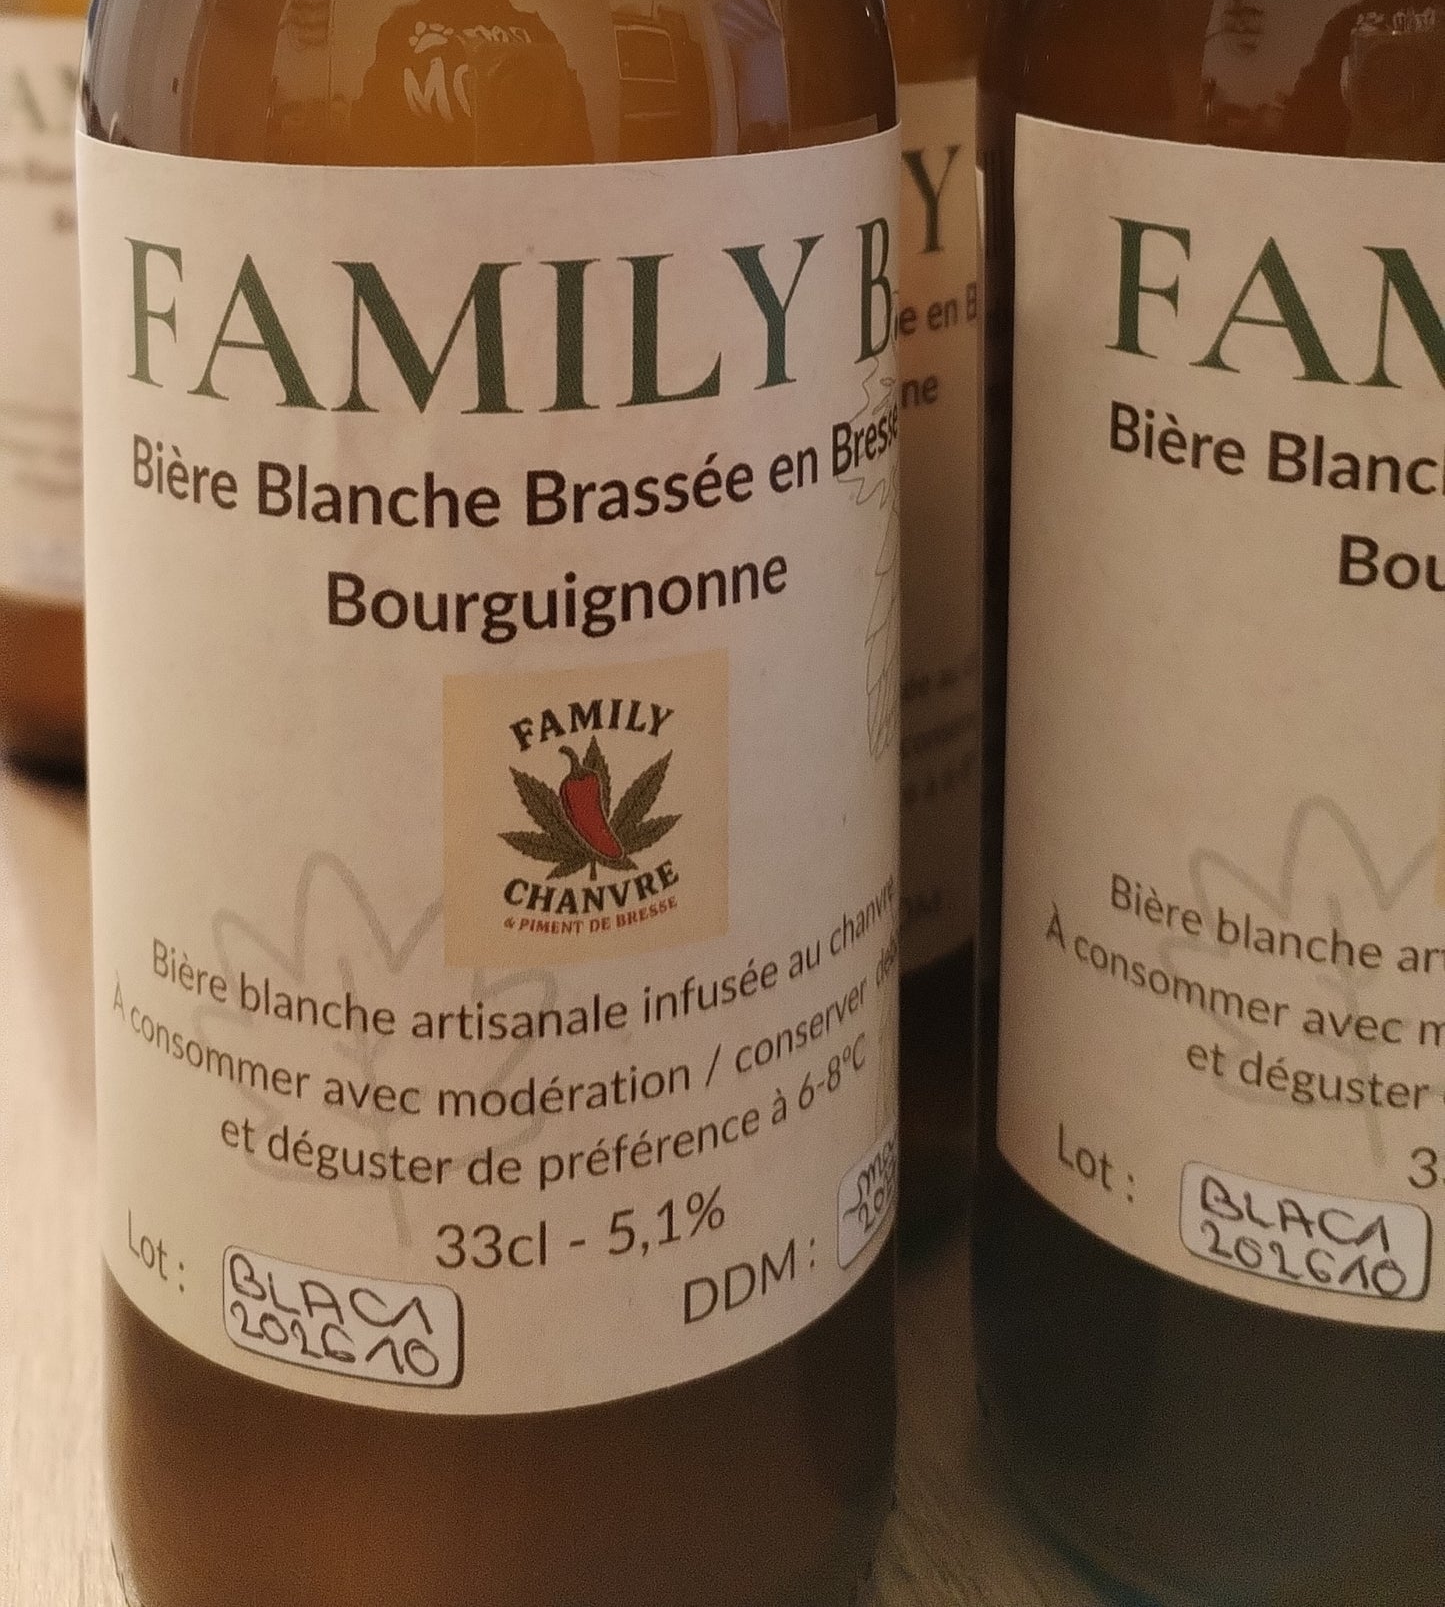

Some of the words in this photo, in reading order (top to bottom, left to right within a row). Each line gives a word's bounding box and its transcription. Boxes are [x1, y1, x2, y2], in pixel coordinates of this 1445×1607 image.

[901, 143, 961, 254] Y
[124, 234, 825, 414] FAMILY
[132, 434, 238, 512] Bière
[257, 460, 501, 529] Blanche
[526, 451, 754, 527] Brassée
[769, 446, 819, 493] en
[1109, 400, 1245, 476] Bière
[1267, 431, 1445, 497] Blanc
[327, 553, 788, 643] Bourguignonne
[509, 698, 674, 752] FAMILY
[503, 859, 679, 914] CHANVRE
[518, 917, 584, 935] PIMENT
[589, 916, 612, 932] DE
[615, 896, 678, 928] BRESSE
[1110, 872, 1202, 937] Bière
[1216, 906, 1383, 969] blanche
[1397, 945, 1445, 973] ar
[151, 937, 228, 1003] Bière
[240, 971, 396, 1037] blanche
[411, 994, 628, 1040] artisanale
[642, 961, 779, 1025] infusée
[788, 942, 822, 978] au
[829, 874, 894, 956] chanvre
[1046, 901, 1066, 950] À
[1074, 933, 1290, 1027] consommer
[1302, 1005, 1403, 1046] avec
[110, 970, 130, 1024] À
[130, 1003, 310, 1101] consommer
[322, 1077, 422, 1117] avec
[437, 1057, 692, 1120] modération
[704, 1045, 722, 1089] /
[734, 976, 868, 1075] conserver
[1186, 1043, 1226, 1076] et
[1238, 1050, 1430, 1111] déguster
[219, 1116, 255, 1153] et
[266, 1125, 452, 1186] déguster
[468, 1145, 522, 1188] de
[538, 1109, 762, 1191] préférence
[771, 1090, 789, 1125] à
[1057, 1123, 1113, 1191] Lot
[1126, 1174, 1134, 1203] :
[1407, 1145, 1445, 1190] 3
[126, 1207, 169, 1282] Lot
[177, 1261, 186, 1293] :
[434, 1220, 547, 1270] 33cl
[569, 1236, 586, 1248] -
[607, 1186, 727, 1259] 5,1%
[682, 1238, 798, 1325] DDM
[808, 1235, 817, 1268] :
